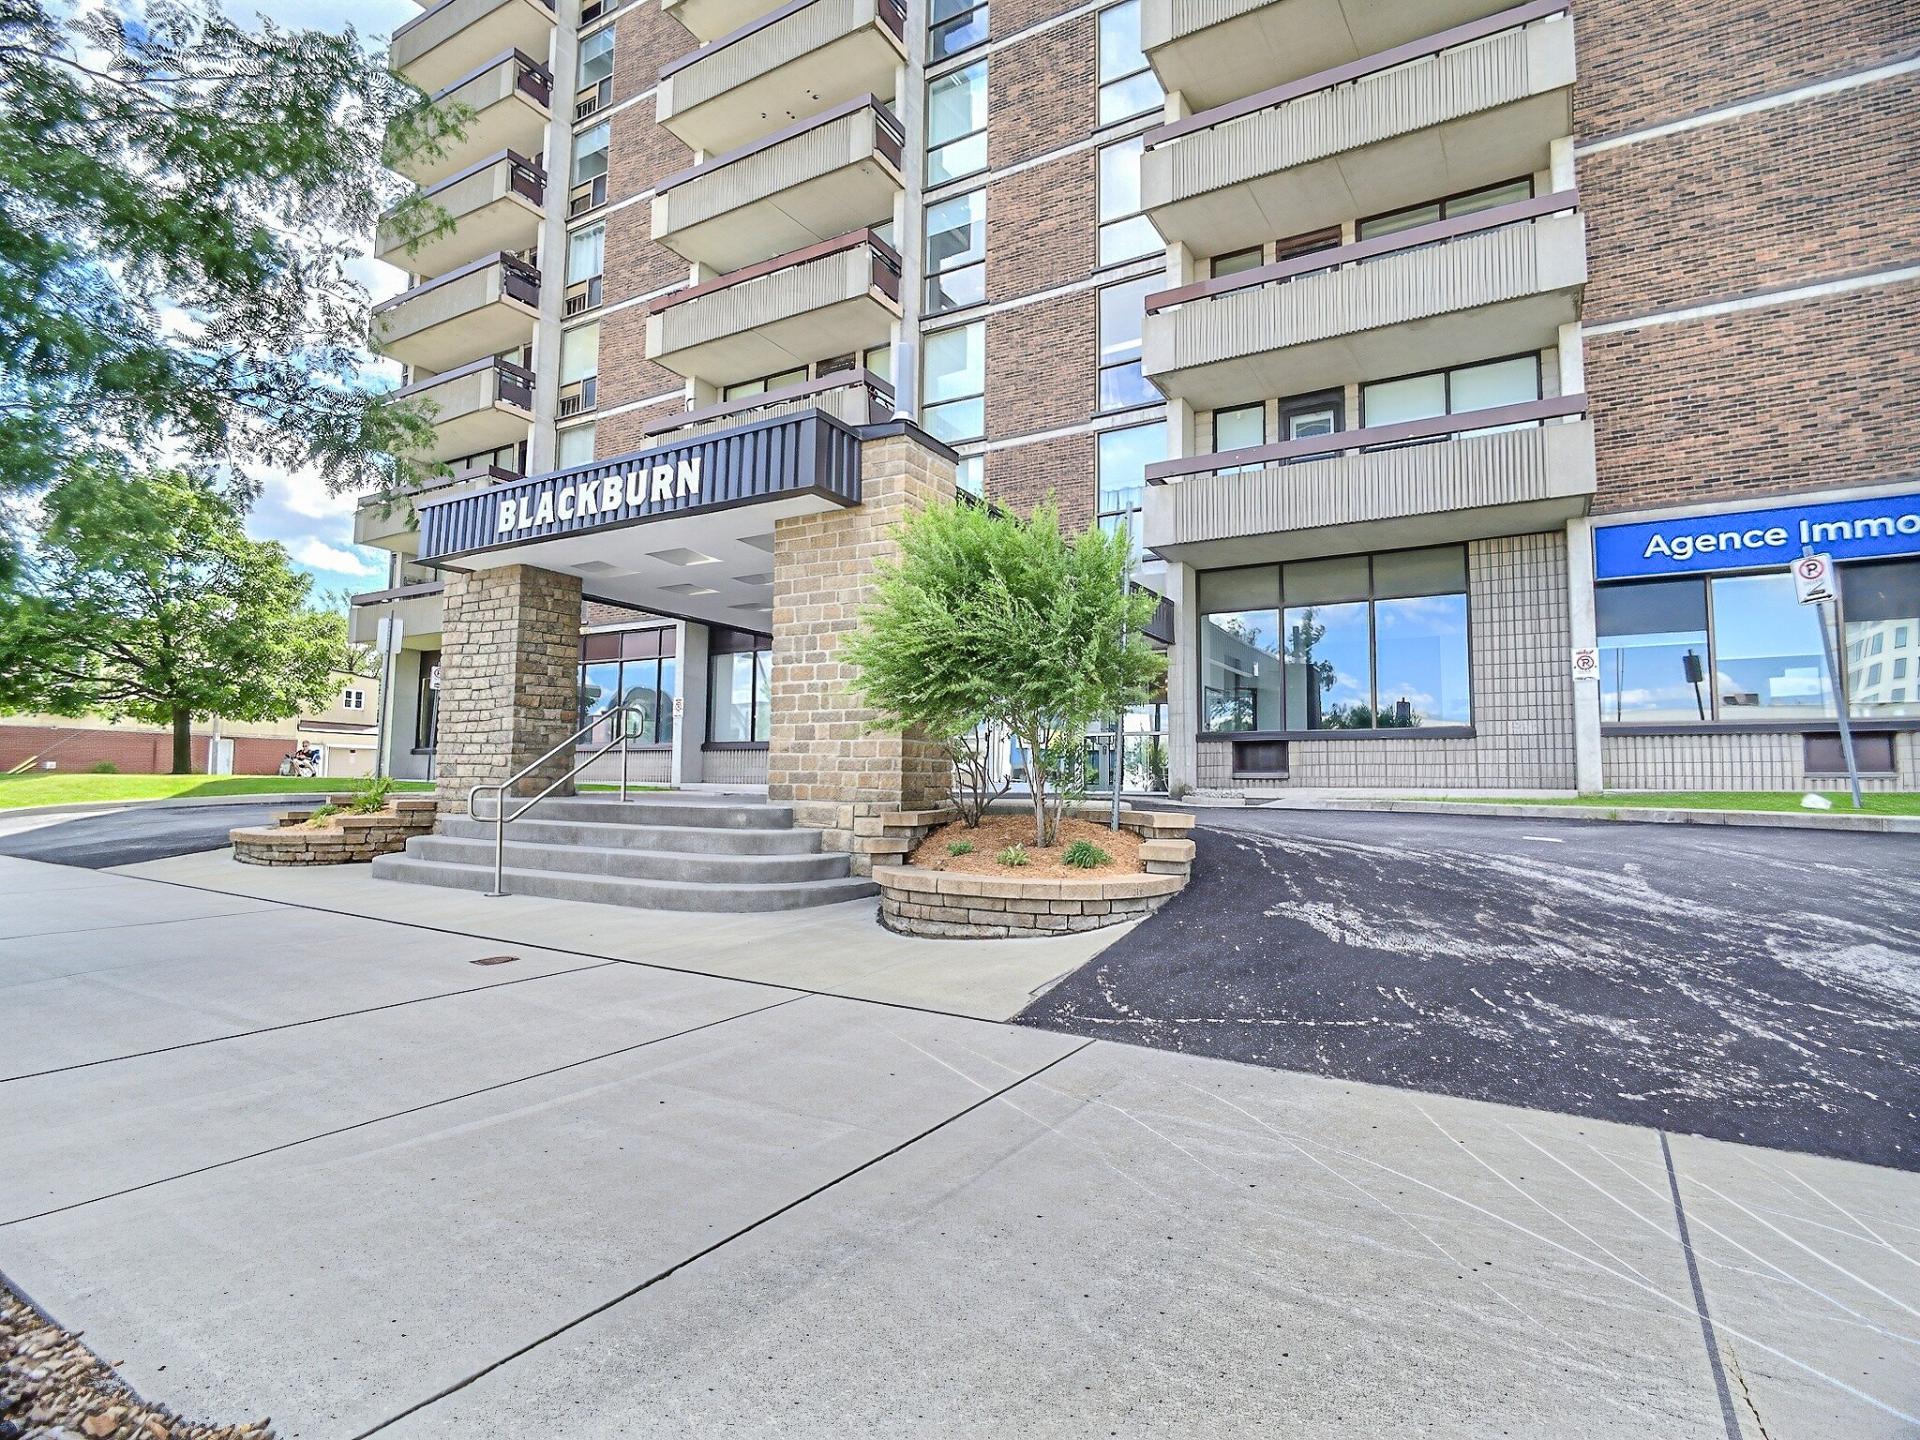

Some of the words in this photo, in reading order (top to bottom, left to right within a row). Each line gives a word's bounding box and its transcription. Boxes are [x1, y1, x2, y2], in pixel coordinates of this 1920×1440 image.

[498, 457, 701, 533] BLACKBURN
[1643, 527, 1789, 561] Agence
[1799, 514, 1920, 544] Immo
